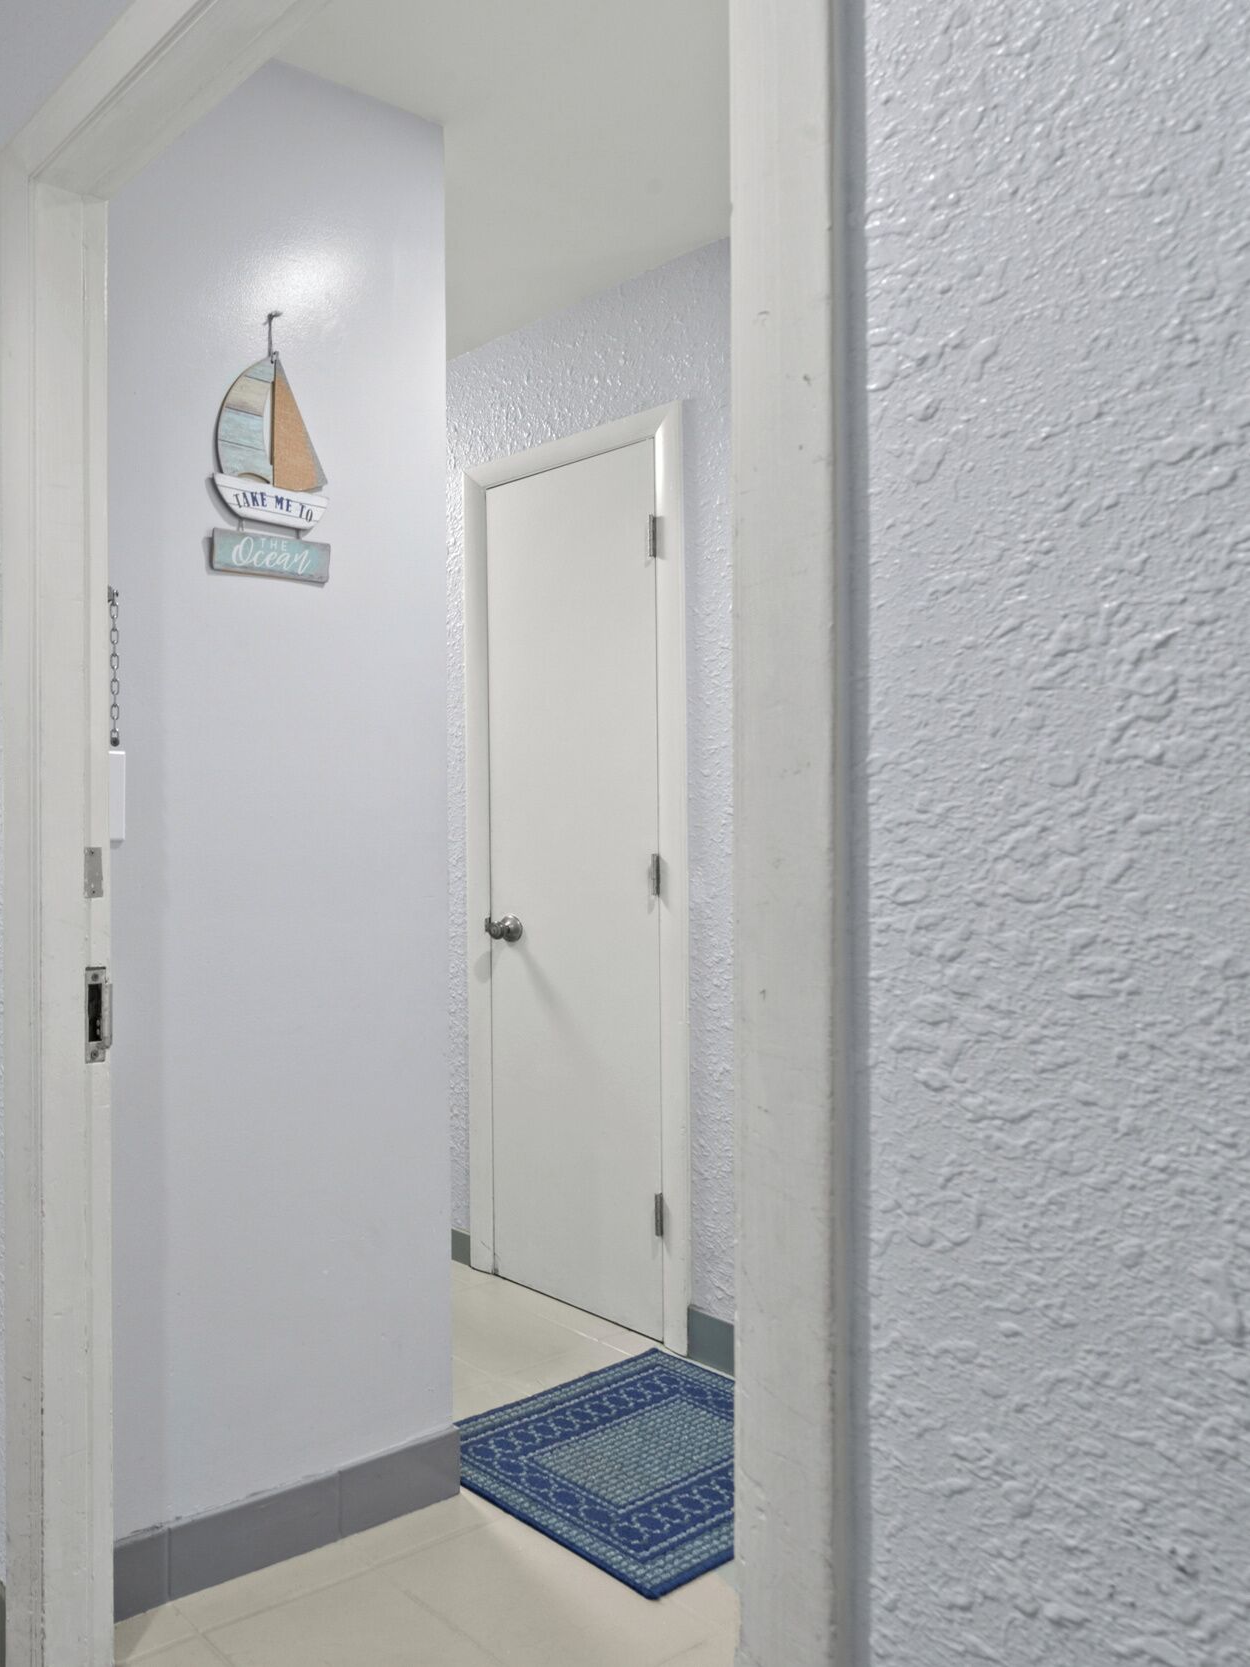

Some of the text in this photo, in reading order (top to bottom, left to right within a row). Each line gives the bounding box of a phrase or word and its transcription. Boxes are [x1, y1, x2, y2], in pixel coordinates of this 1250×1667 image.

[233, 492, 313, 522] TAKE ME TO
[231, 536, 311, 574] Ocean
[259, 539, 288, 551] THE
